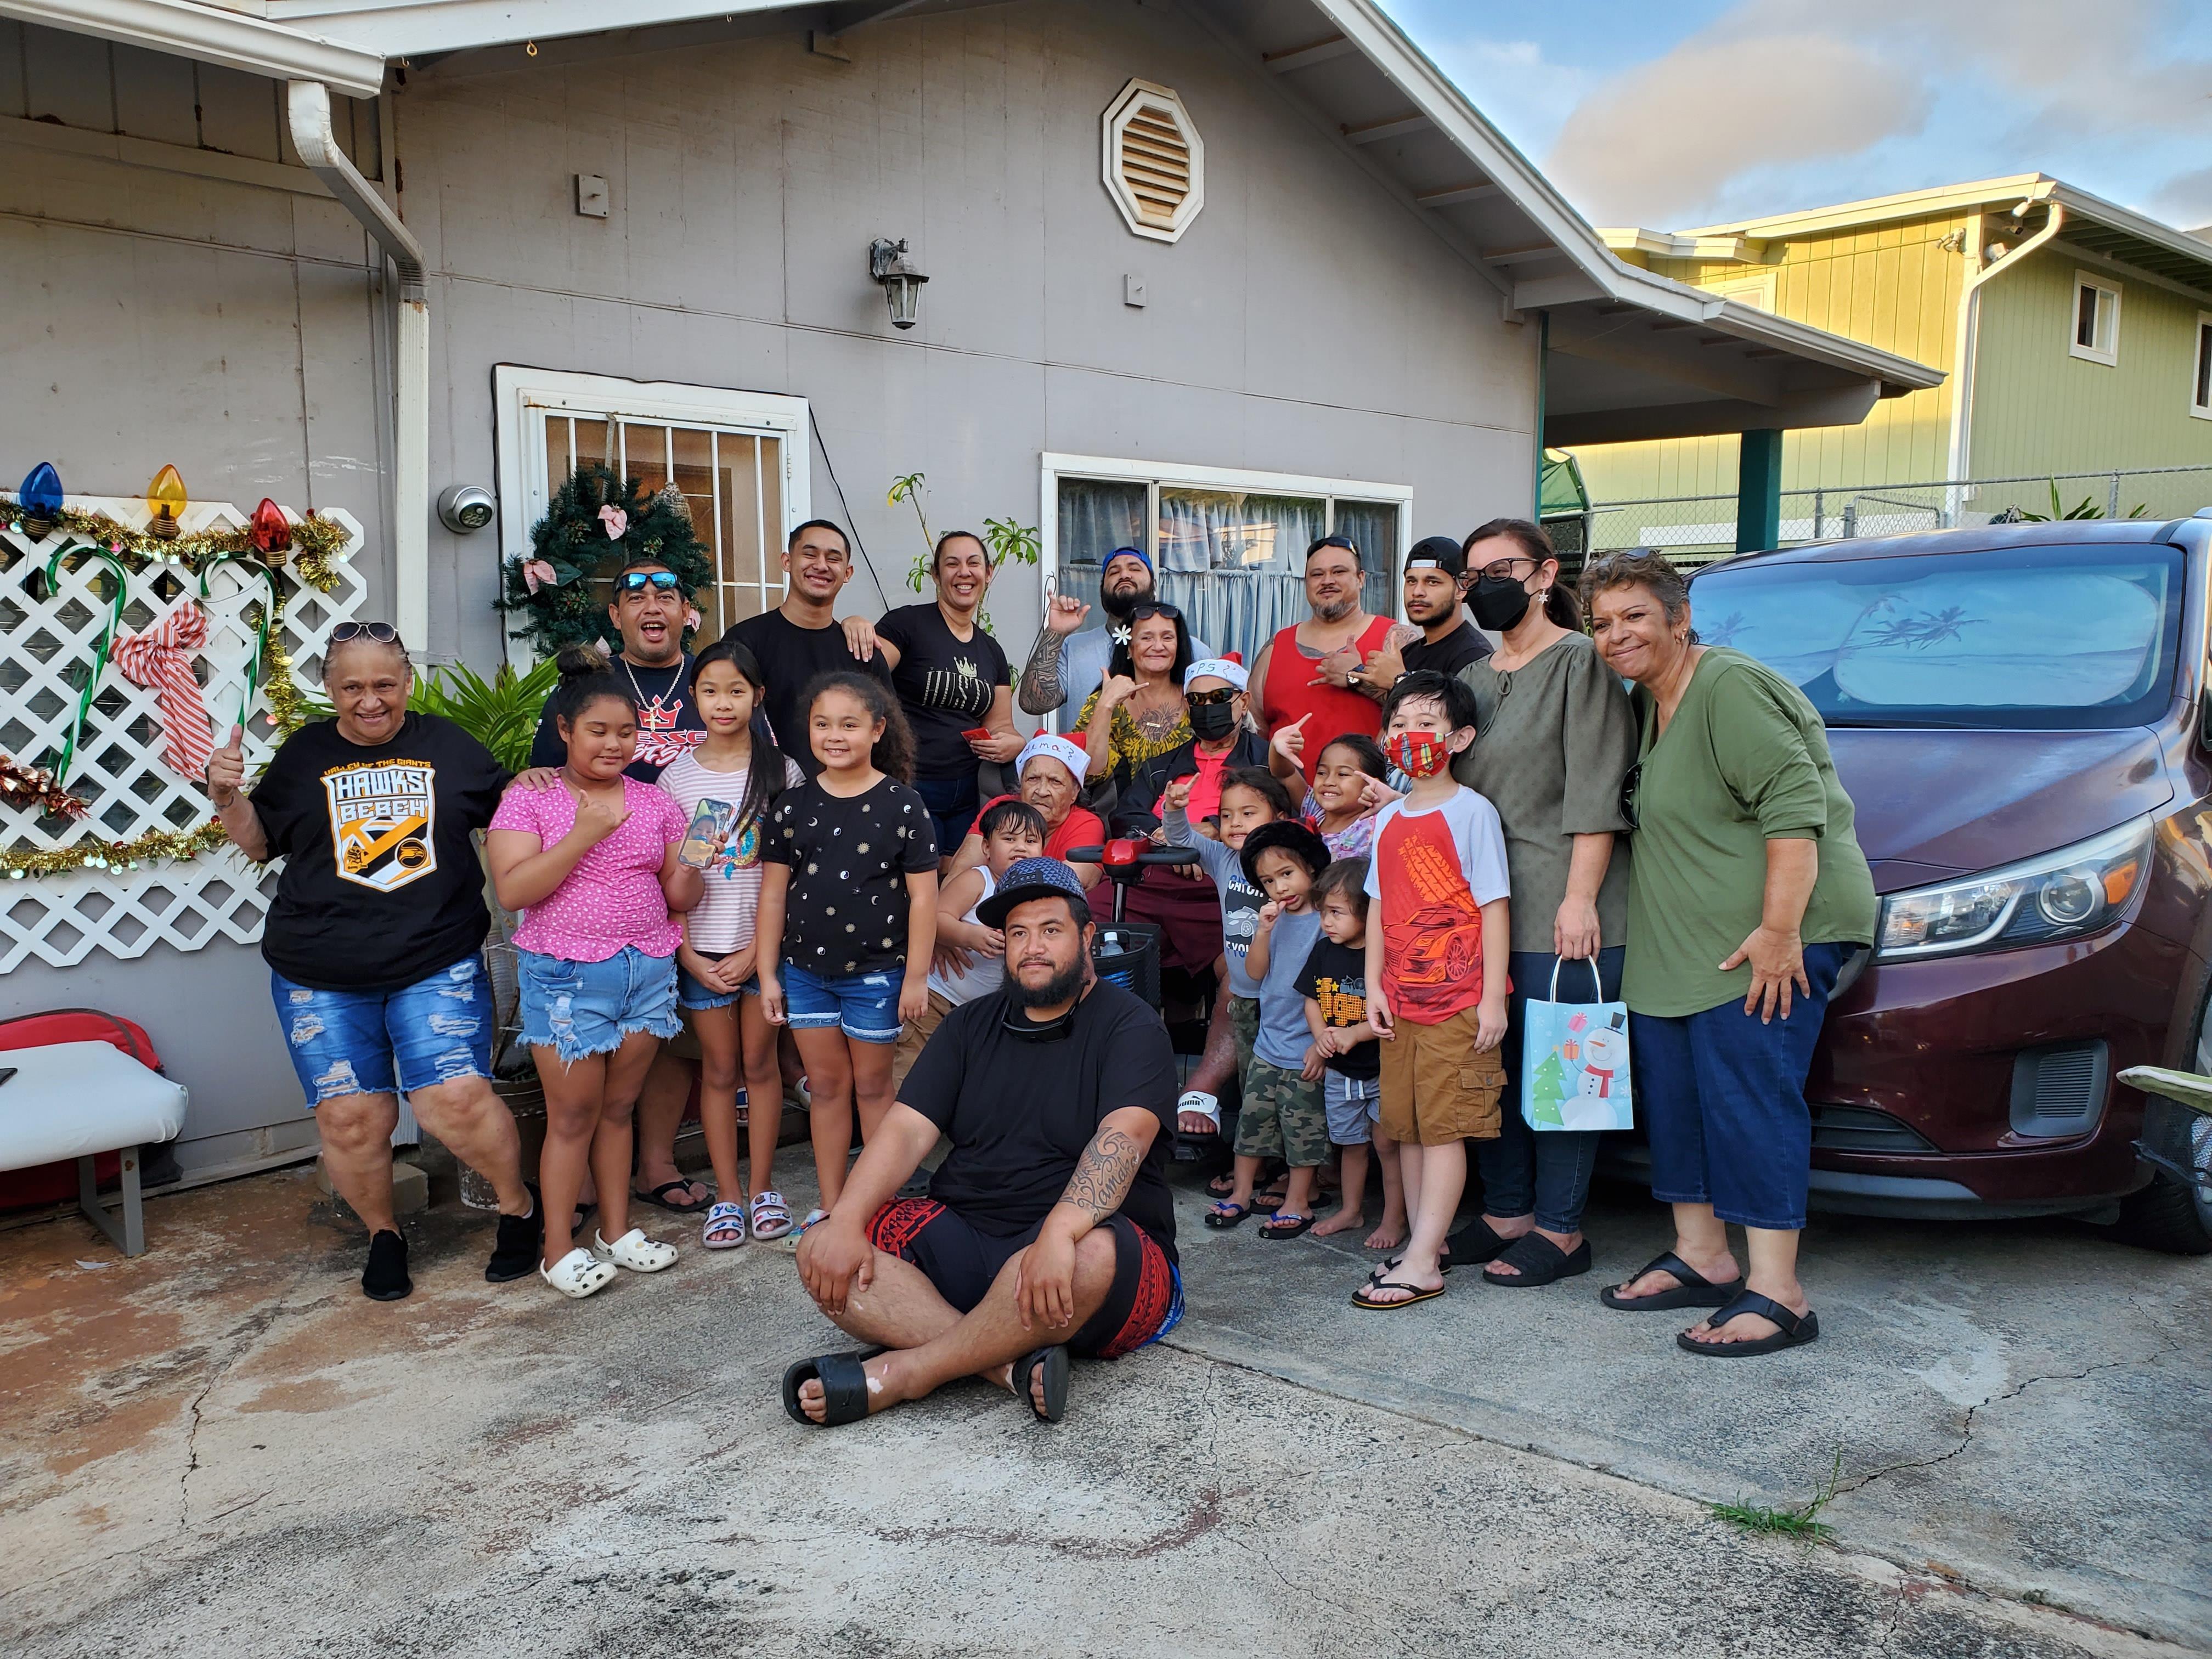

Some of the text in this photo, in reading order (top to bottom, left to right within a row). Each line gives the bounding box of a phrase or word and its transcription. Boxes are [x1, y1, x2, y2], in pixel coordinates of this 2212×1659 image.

[324, 761, 360, 775] VALLEY
[376, 759, 396, 768] THE
[397, 758, 431, 768] GIANTS
[336, 771, 426, 799] HAWKS
[340, 800, 426, 822] BEBEH
